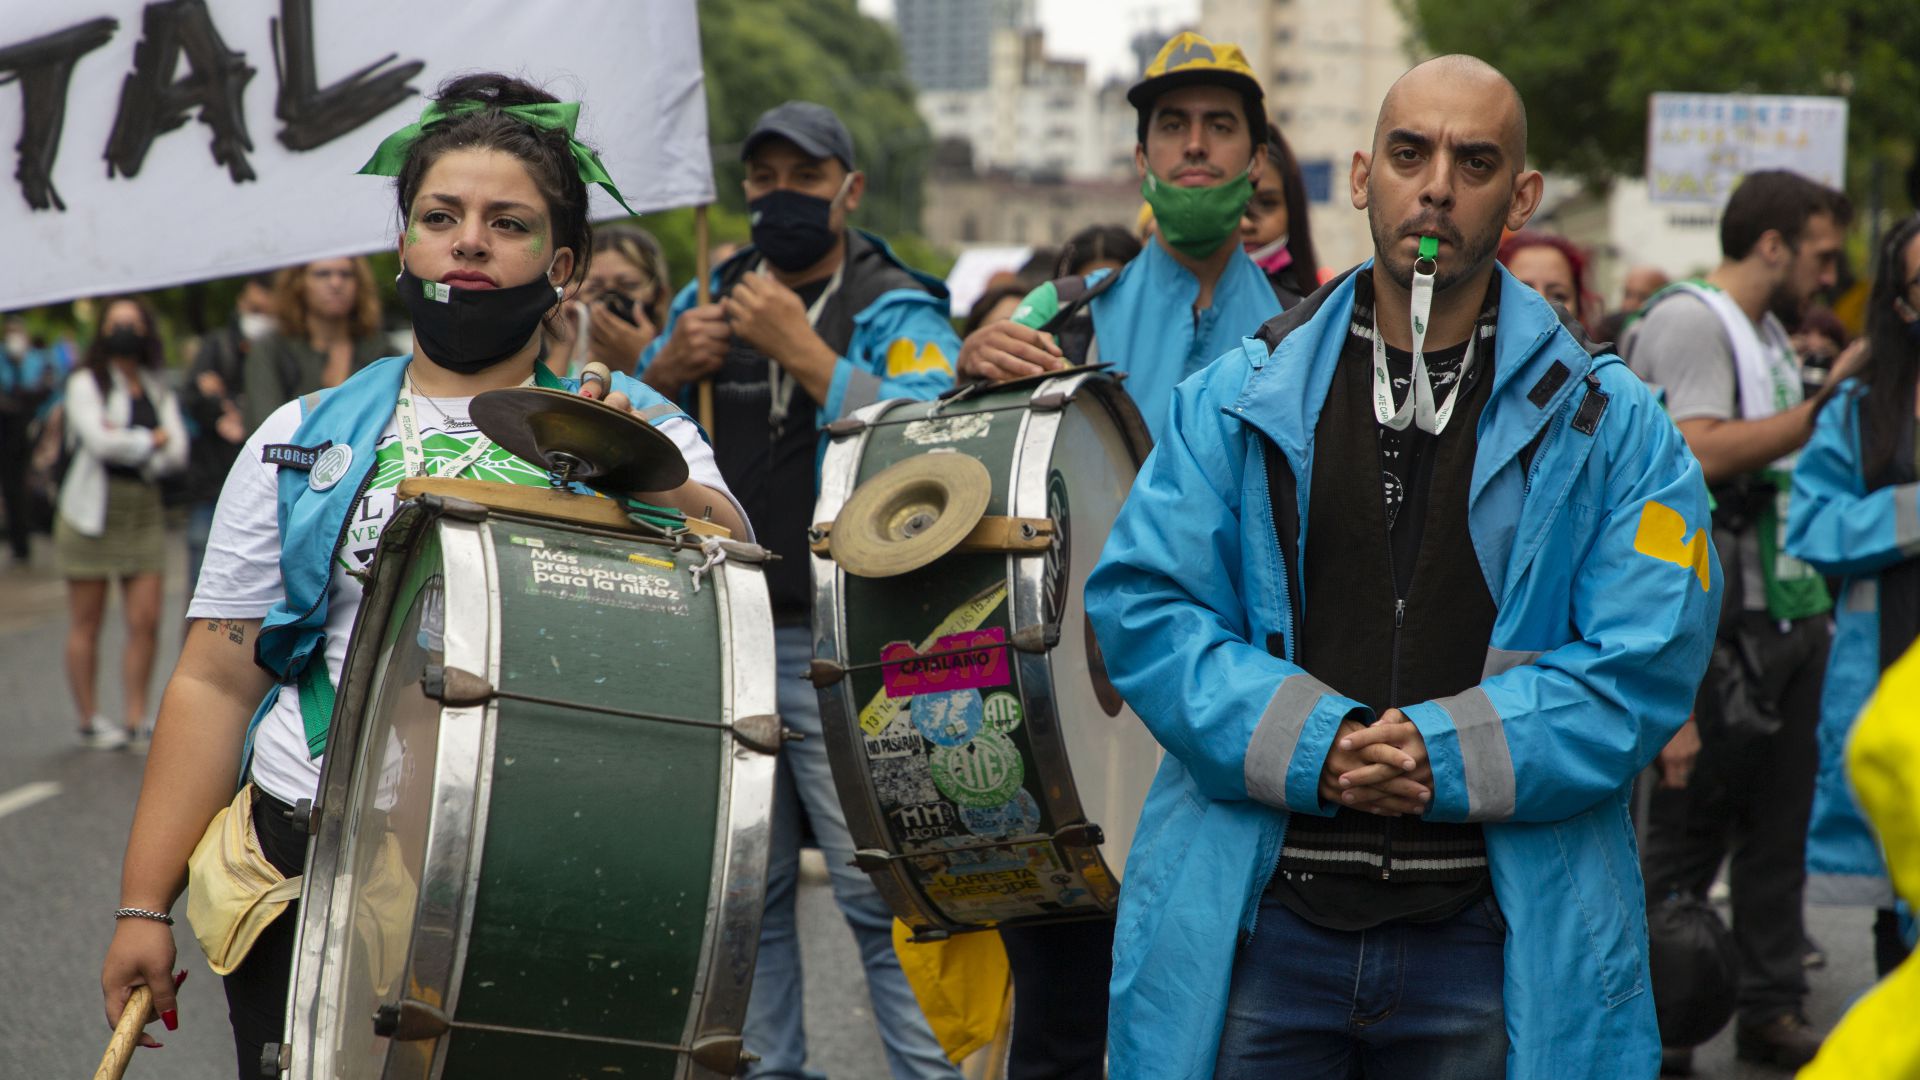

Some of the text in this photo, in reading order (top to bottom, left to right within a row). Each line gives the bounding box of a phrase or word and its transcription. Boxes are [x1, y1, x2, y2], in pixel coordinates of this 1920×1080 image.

[269, 448, 315, 465] FLORES
[530, 548, 579, 565] Más
[533, 571, 681, 601] para la niñez
[901, 650, 991, 675] CATALANO
